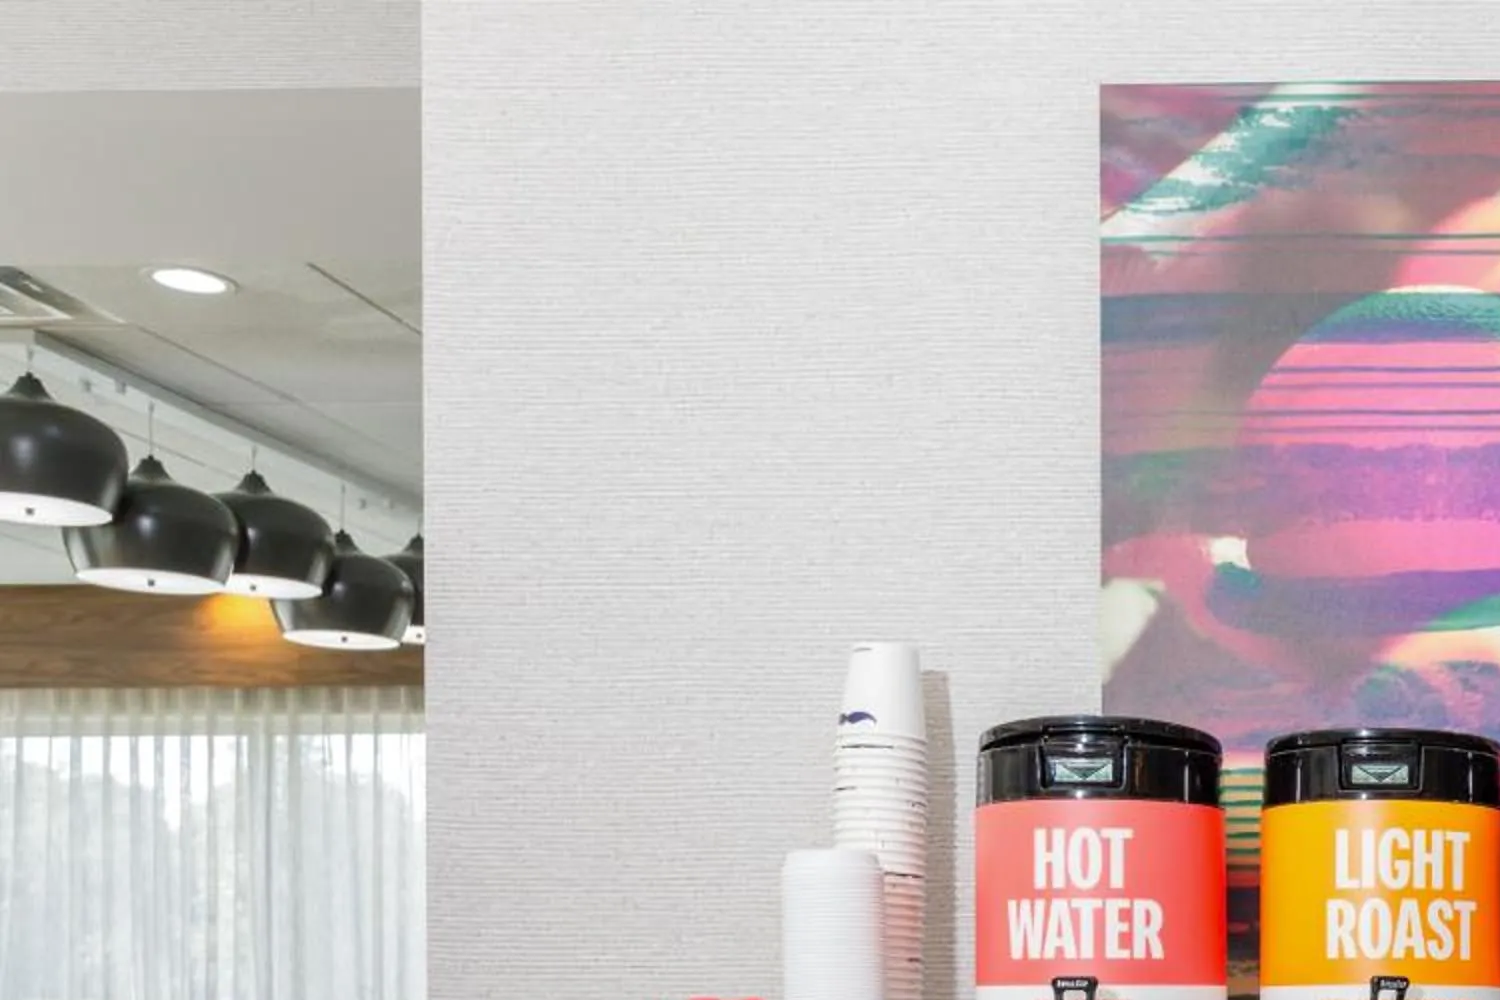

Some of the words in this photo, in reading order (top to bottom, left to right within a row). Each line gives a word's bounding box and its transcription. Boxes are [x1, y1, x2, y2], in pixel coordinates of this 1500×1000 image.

[1034, 826, 1134, 890] HOT
[1335, 828, 1470, 891] LIGHT
[1007, 898, 1165, 960] WATER
[1326, 898, 1477, 960] ROAST
